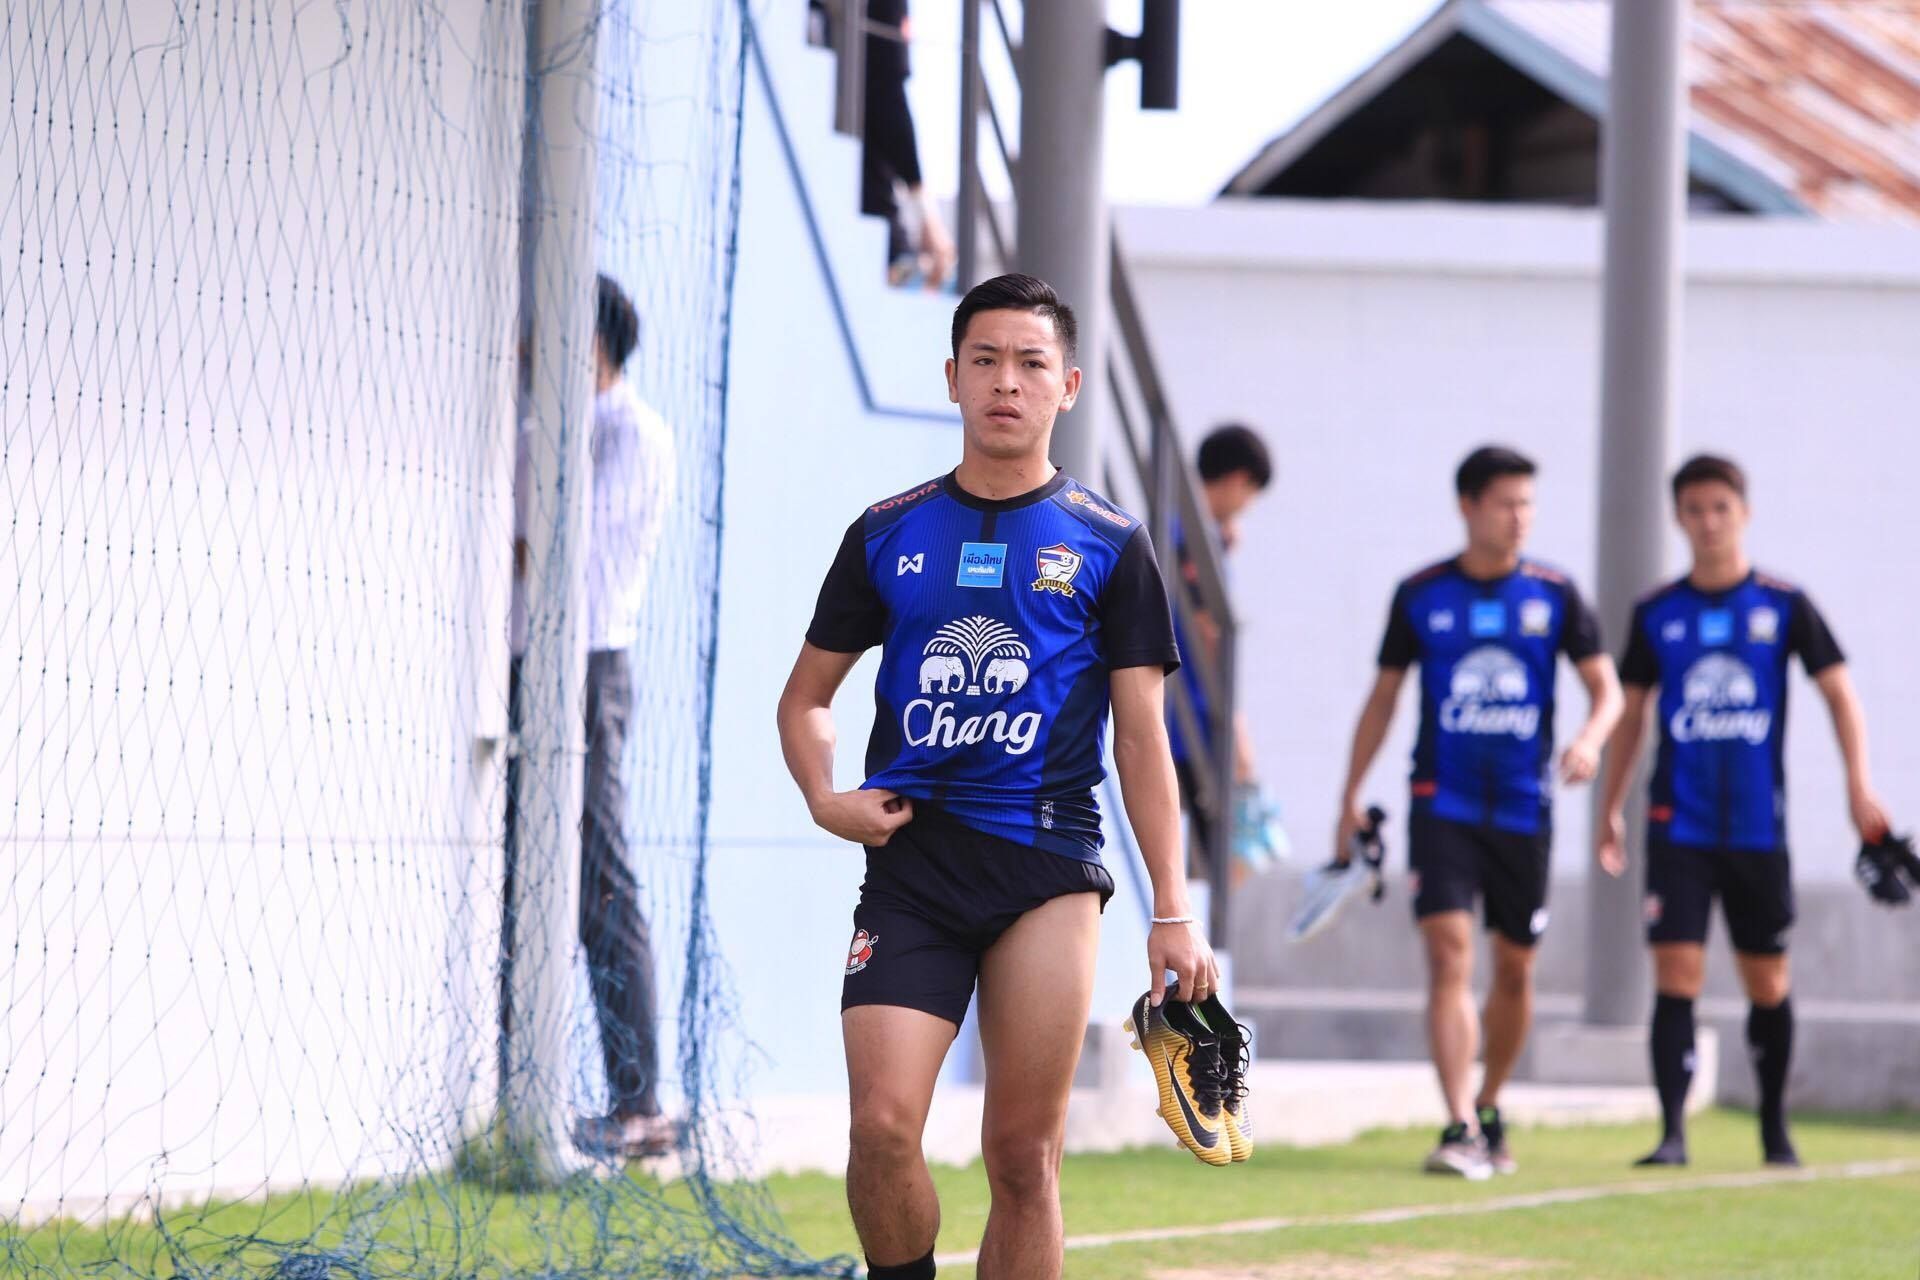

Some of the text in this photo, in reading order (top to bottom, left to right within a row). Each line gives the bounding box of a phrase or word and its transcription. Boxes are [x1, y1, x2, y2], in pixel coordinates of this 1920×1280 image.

[870, 482, 938, 512] TOYOTA
[903, 698, 1043, 755] Chang
[1440, 699, 1540, 740] Chang
[1670, 705, 1771, 745] Chang
